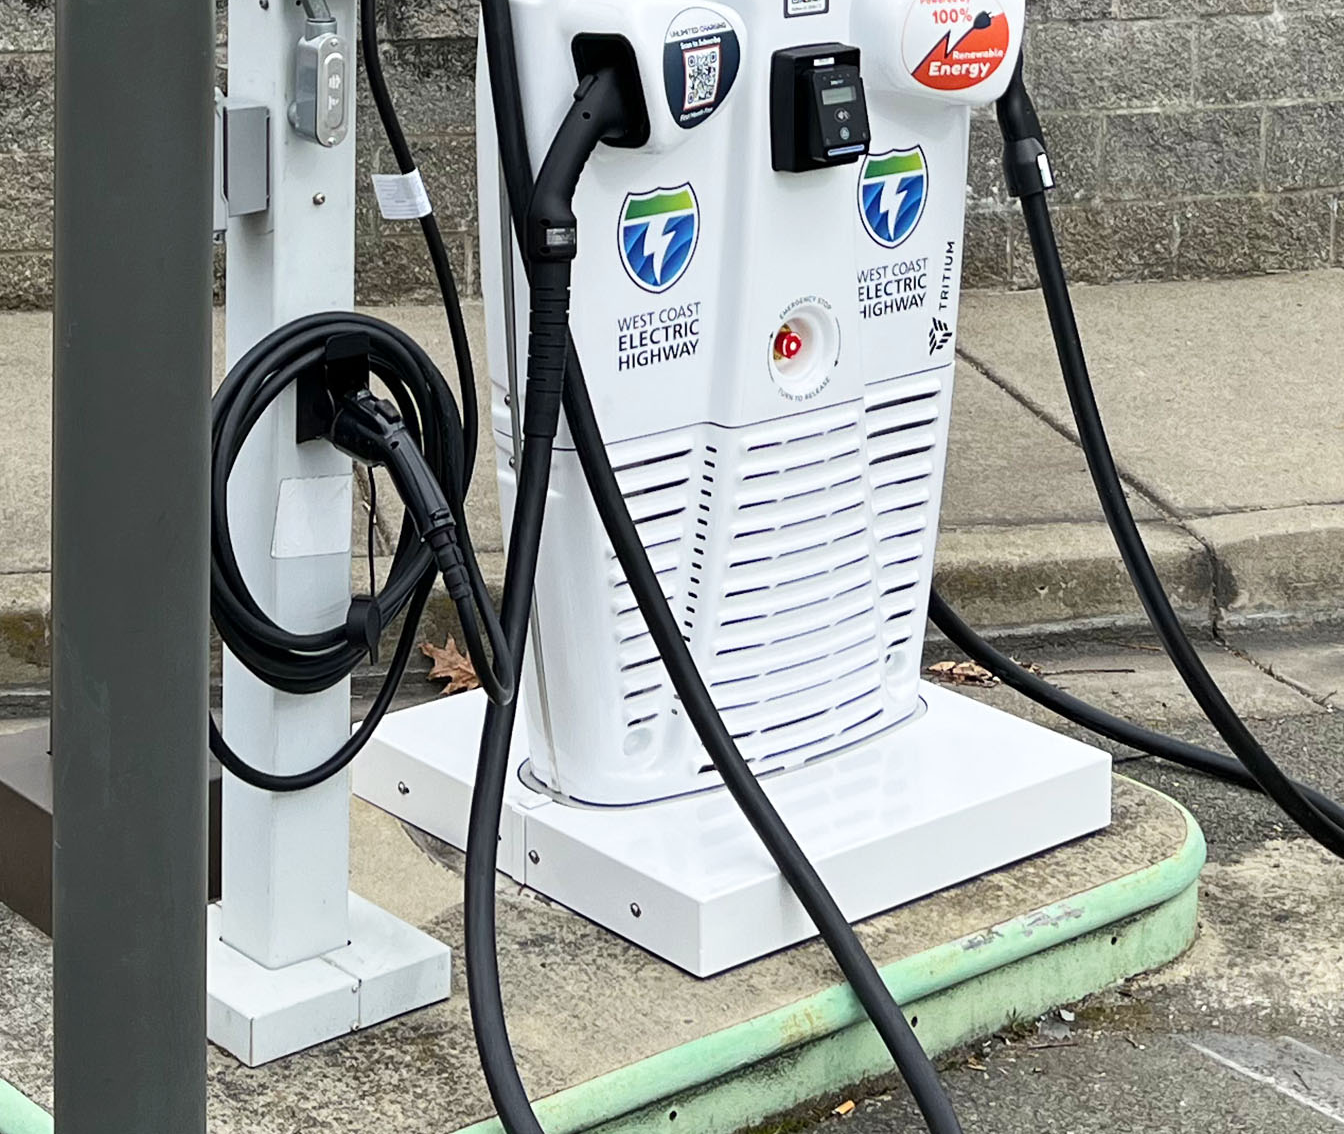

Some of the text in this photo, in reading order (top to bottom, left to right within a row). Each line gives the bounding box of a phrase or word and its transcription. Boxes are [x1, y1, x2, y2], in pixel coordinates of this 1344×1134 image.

[932, 7, 973, 24] 100%
[670, 26, 699, 38] UNLIMITED
[952, 48, 1003, 60] Renewable
[928, 61, 991, 78] Energy
[857, 257, 929, 284] WEST COAST
[938, 241, 955, 312] TRITIUM
[858, 273, 927, 302] ELECTRIC
[617, 301, 701, 332] WEST COAST
[779, 295, 832, 320] EMERGENCY STOP
[860, 292, 927, 319] HIGHWAY
[618, 318, 700, 352] ELECTRIC
[618, 338, 700, 372] HIGHWAY
[804, 376, 831, 400] RELEASE
